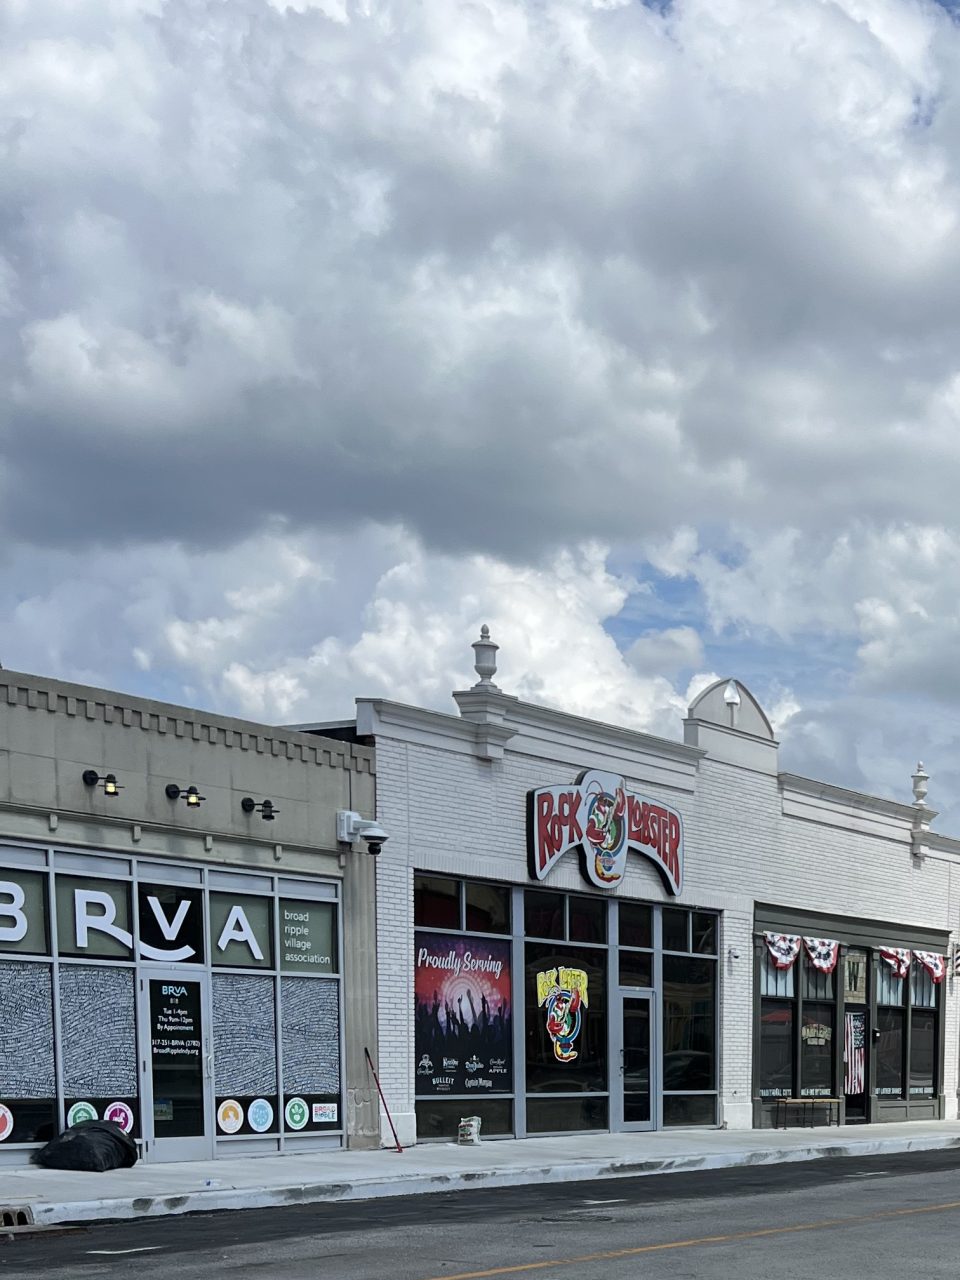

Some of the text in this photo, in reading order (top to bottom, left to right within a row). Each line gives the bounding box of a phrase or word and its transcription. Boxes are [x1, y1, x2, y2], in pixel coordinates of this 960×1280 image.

[537, 789, 680, 889] ROCK LOBSTER
[284, 909, 310, 922] broad
[284, 924, 310, 937] ripple
[284, 938, 312, 951] village
[284, 953, 331, 964] association
[417, 947, 503, 980] Proudly Serving
[162, 985, 188, 996] BRVA
[432, 1077, 455, 1085] BULLEIT
[314, 1112, 336, 1120] RIPPLE
